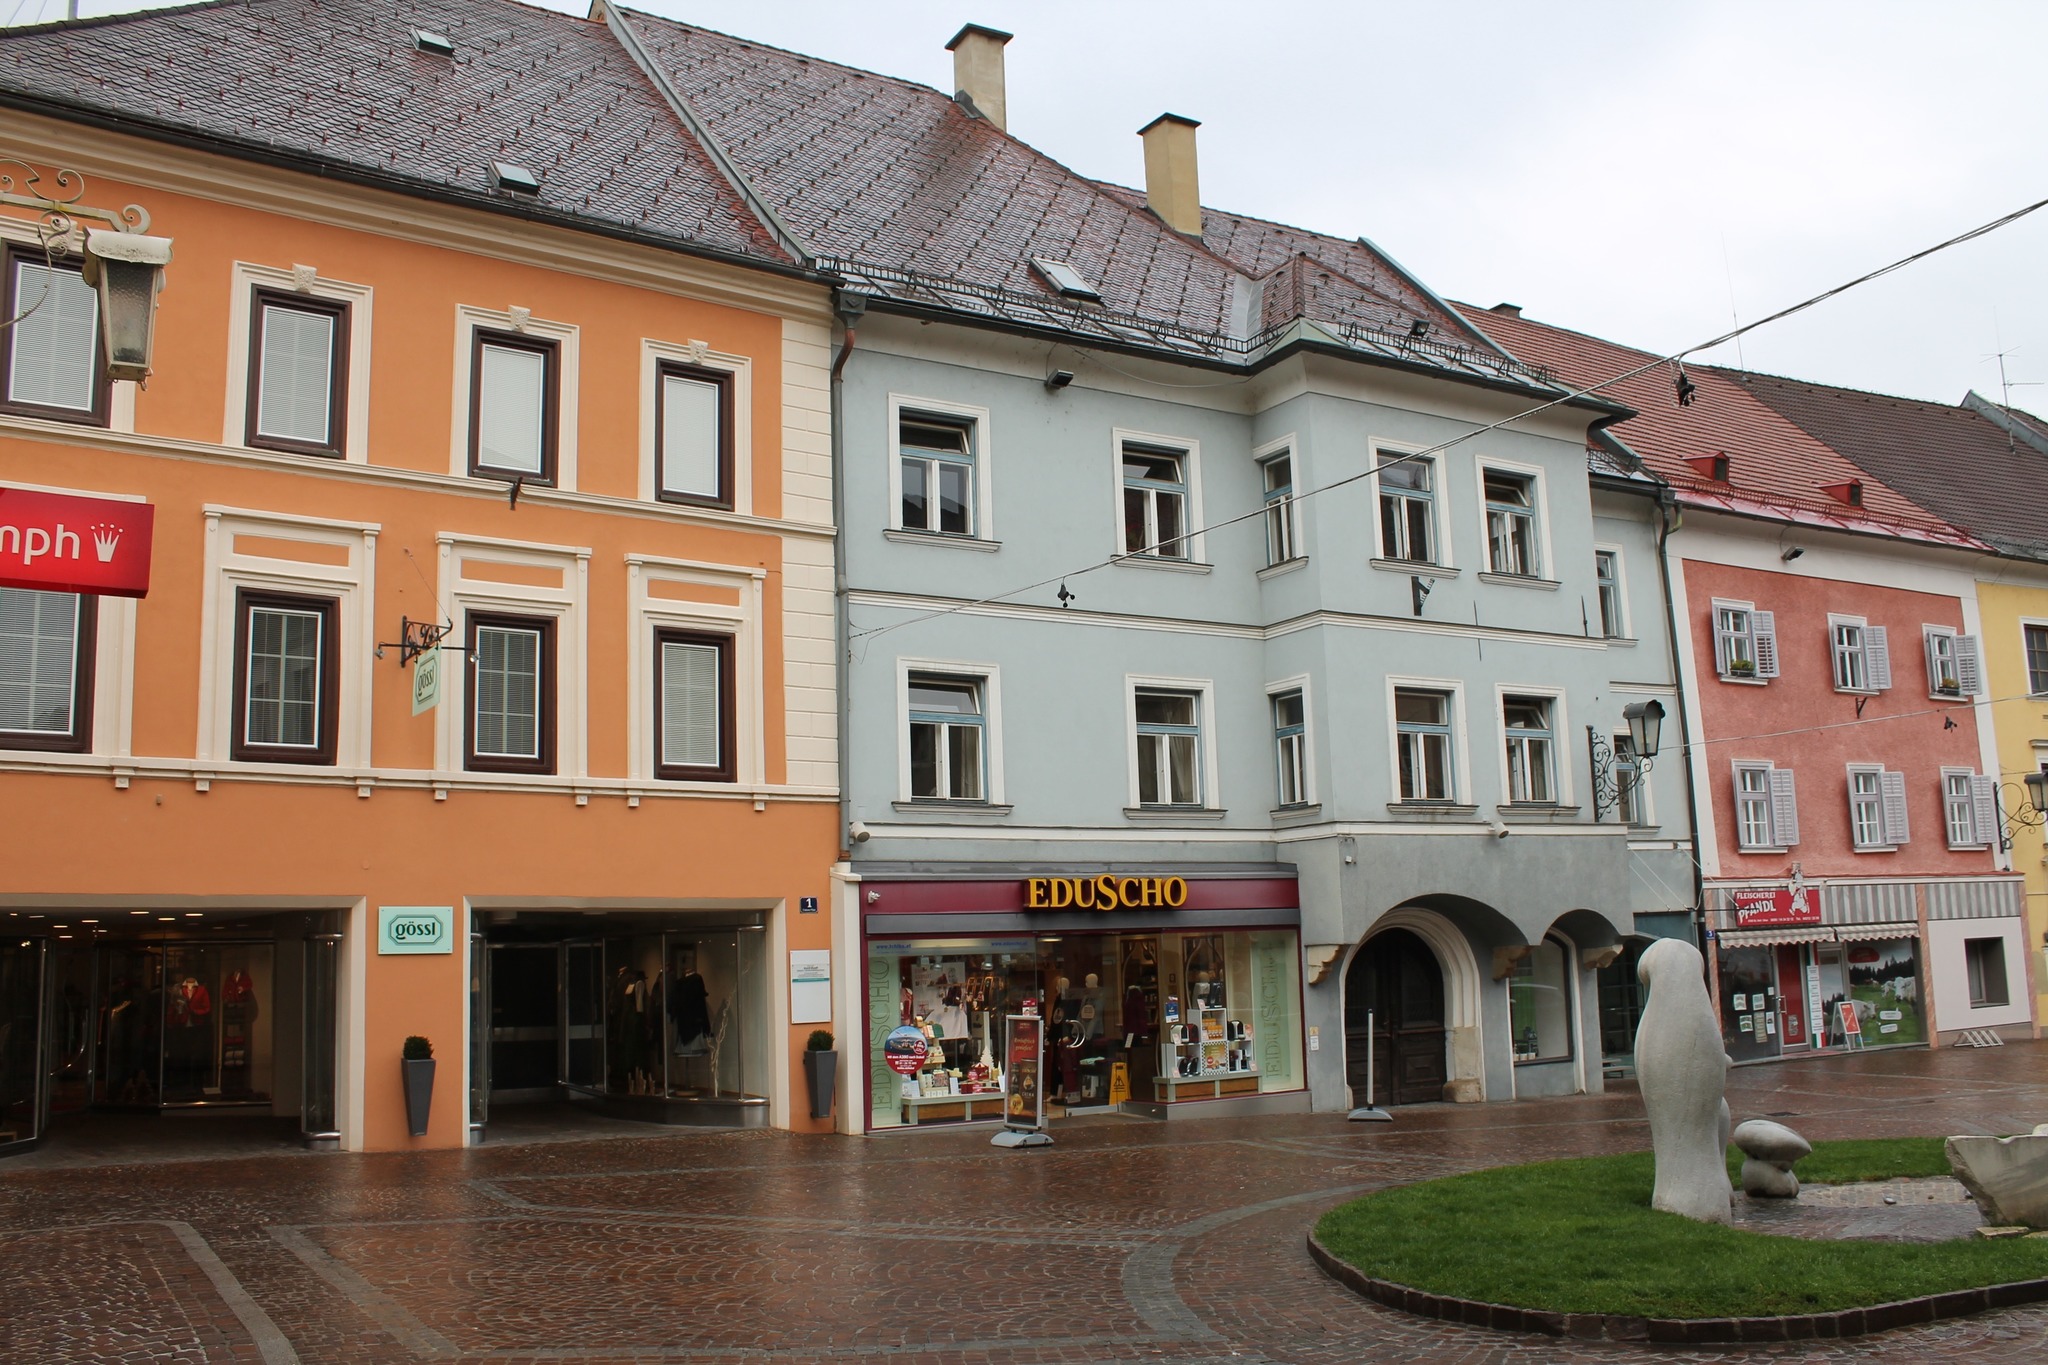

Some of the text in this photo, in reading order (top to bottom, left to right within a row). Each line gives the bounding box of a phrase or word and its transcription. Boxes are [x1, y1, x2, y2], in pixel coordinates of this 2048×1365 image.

[805, 897, 812, 908] 1
[1028, 874, 1188, 911] EDUSCHO
[1738, 900, 1777, 924] PFANDL
[395, 921, 436, 940] gössl
